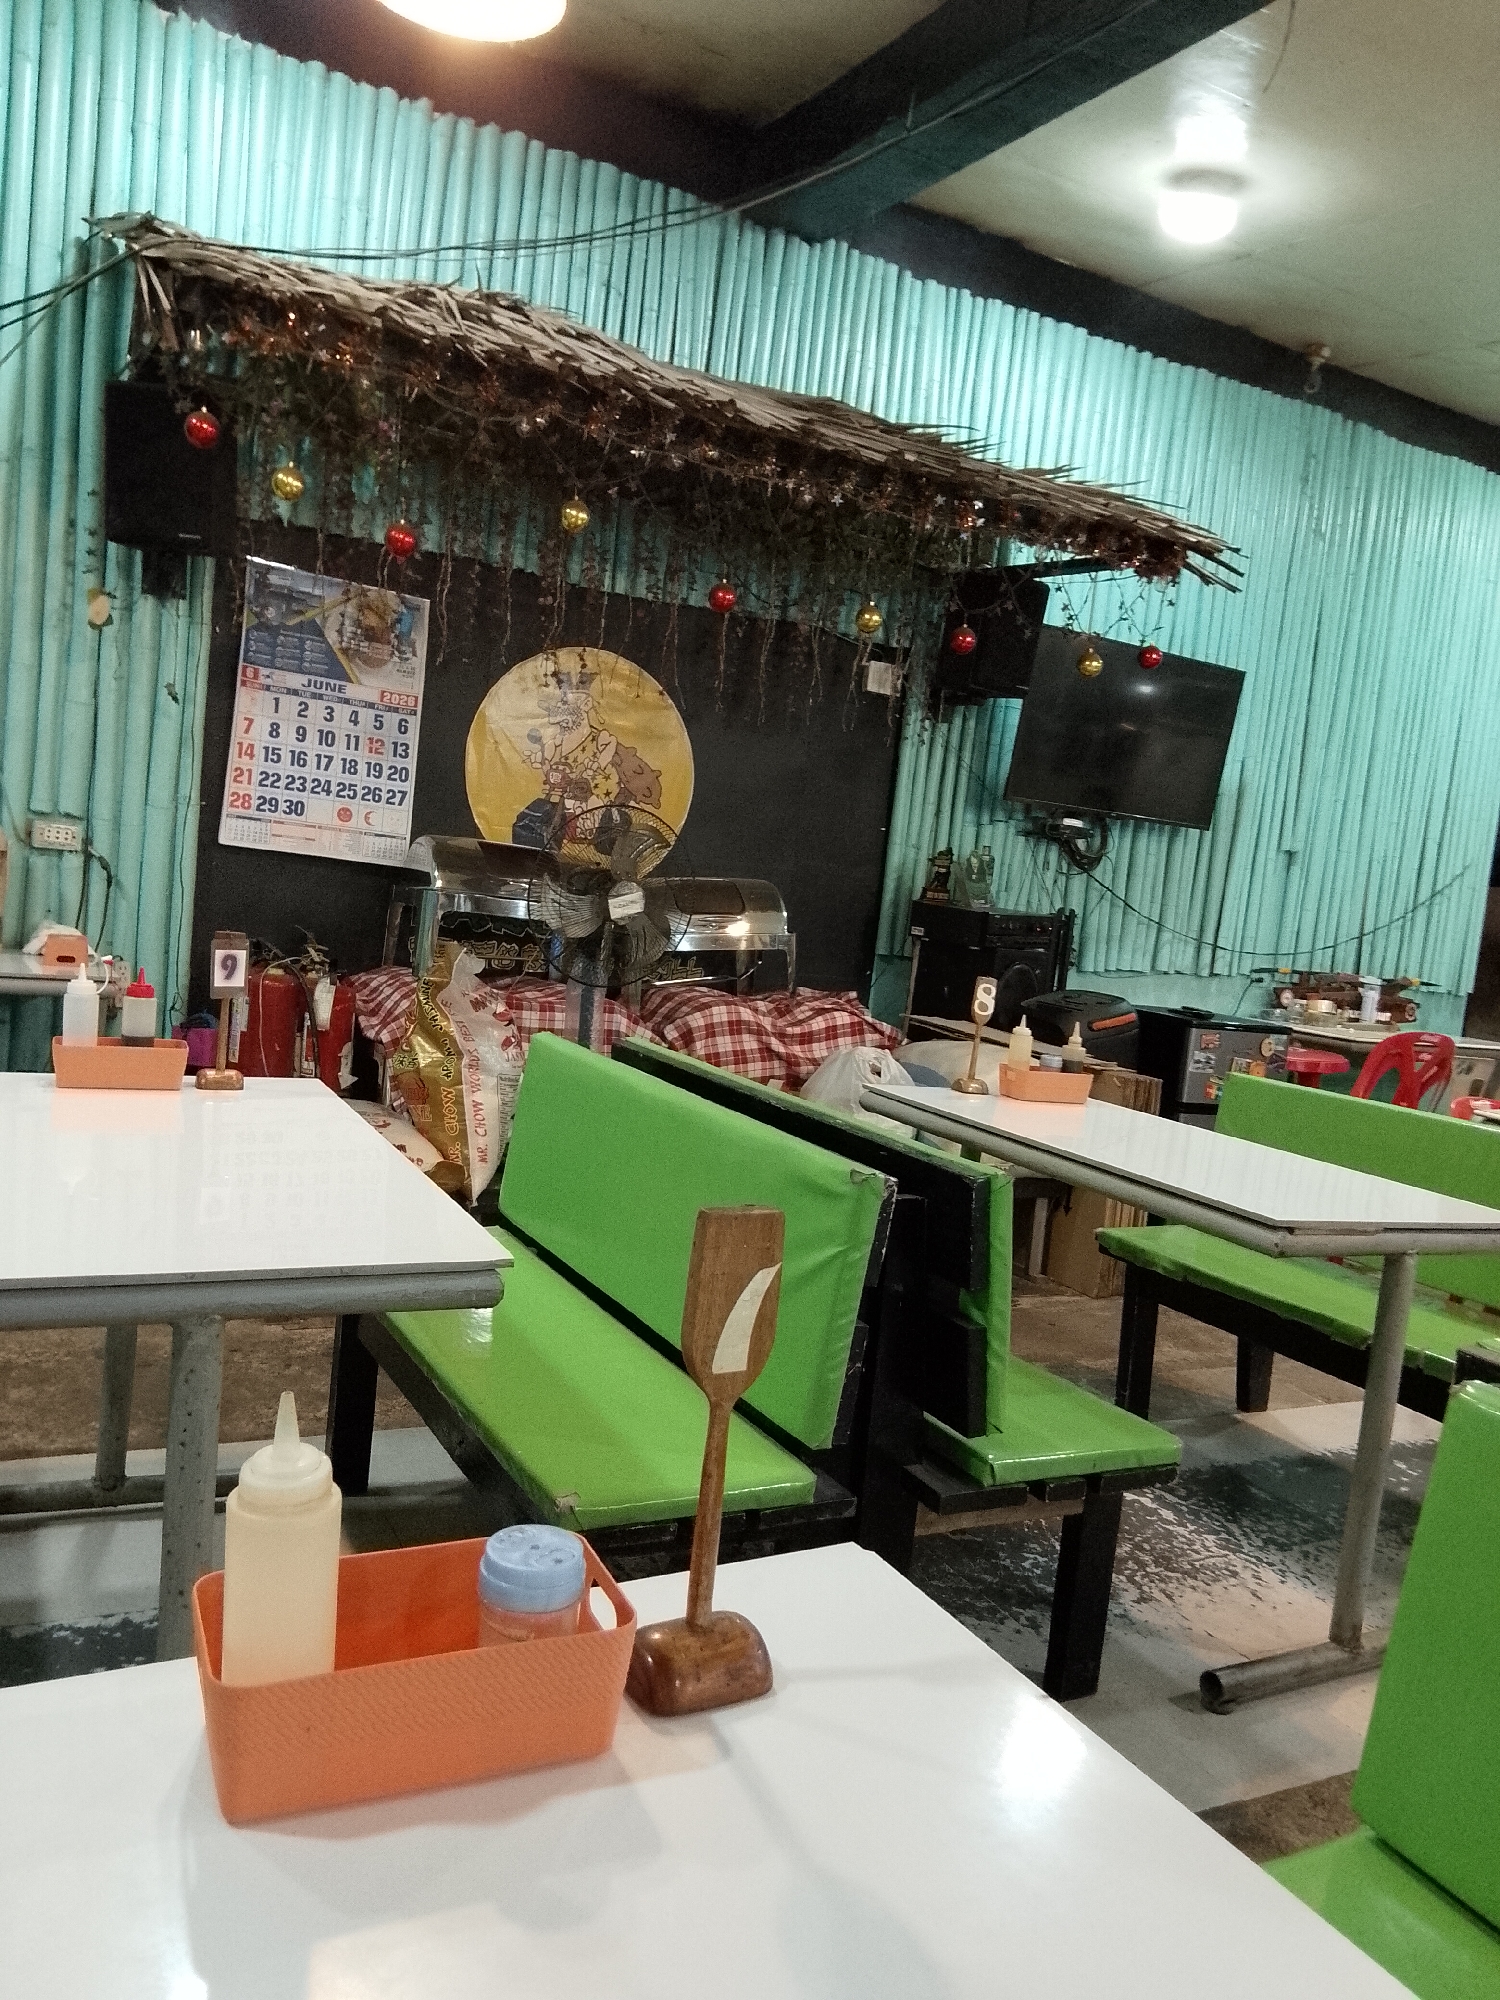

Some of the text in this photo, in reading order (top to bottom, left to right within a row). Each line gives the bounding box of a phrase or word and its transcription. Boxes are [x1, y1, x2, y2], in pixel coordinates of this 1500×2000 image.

[245, 667, 255, 679] 6
[301, 678, 347, 694] JUNE
[269, 685, 287, 694] MON
[298, 690, 312, 698] TUE
[322, 694, 338, 702] WED
[382, 691, 416, 707] 2026
[273, 697, 409, 735] 1 2 3 4 5 6
[243, 717, 410, 759] 7 8 9 10 11 12 13
[236, 742, 410, 782] 14 15 16 17 18 19 20
[229, 792, 305, 816] 28 29 30
[232, 766, 408, 806] 21 22 23 24 25 26 27
[220, 953, 238, 981] 9
[419, 976, 444, 1032] JASMINE
[974, 983, 996, 1015] 8
[440, 1038, 456, 1081] AROMA
[468, 1048, 482, 1094] WORLDS
[441, 1087, 459, 1135] CHOW
[472, 1100, 487, 1137] CHOW
[477, 1144, 488, 1164] MR.
